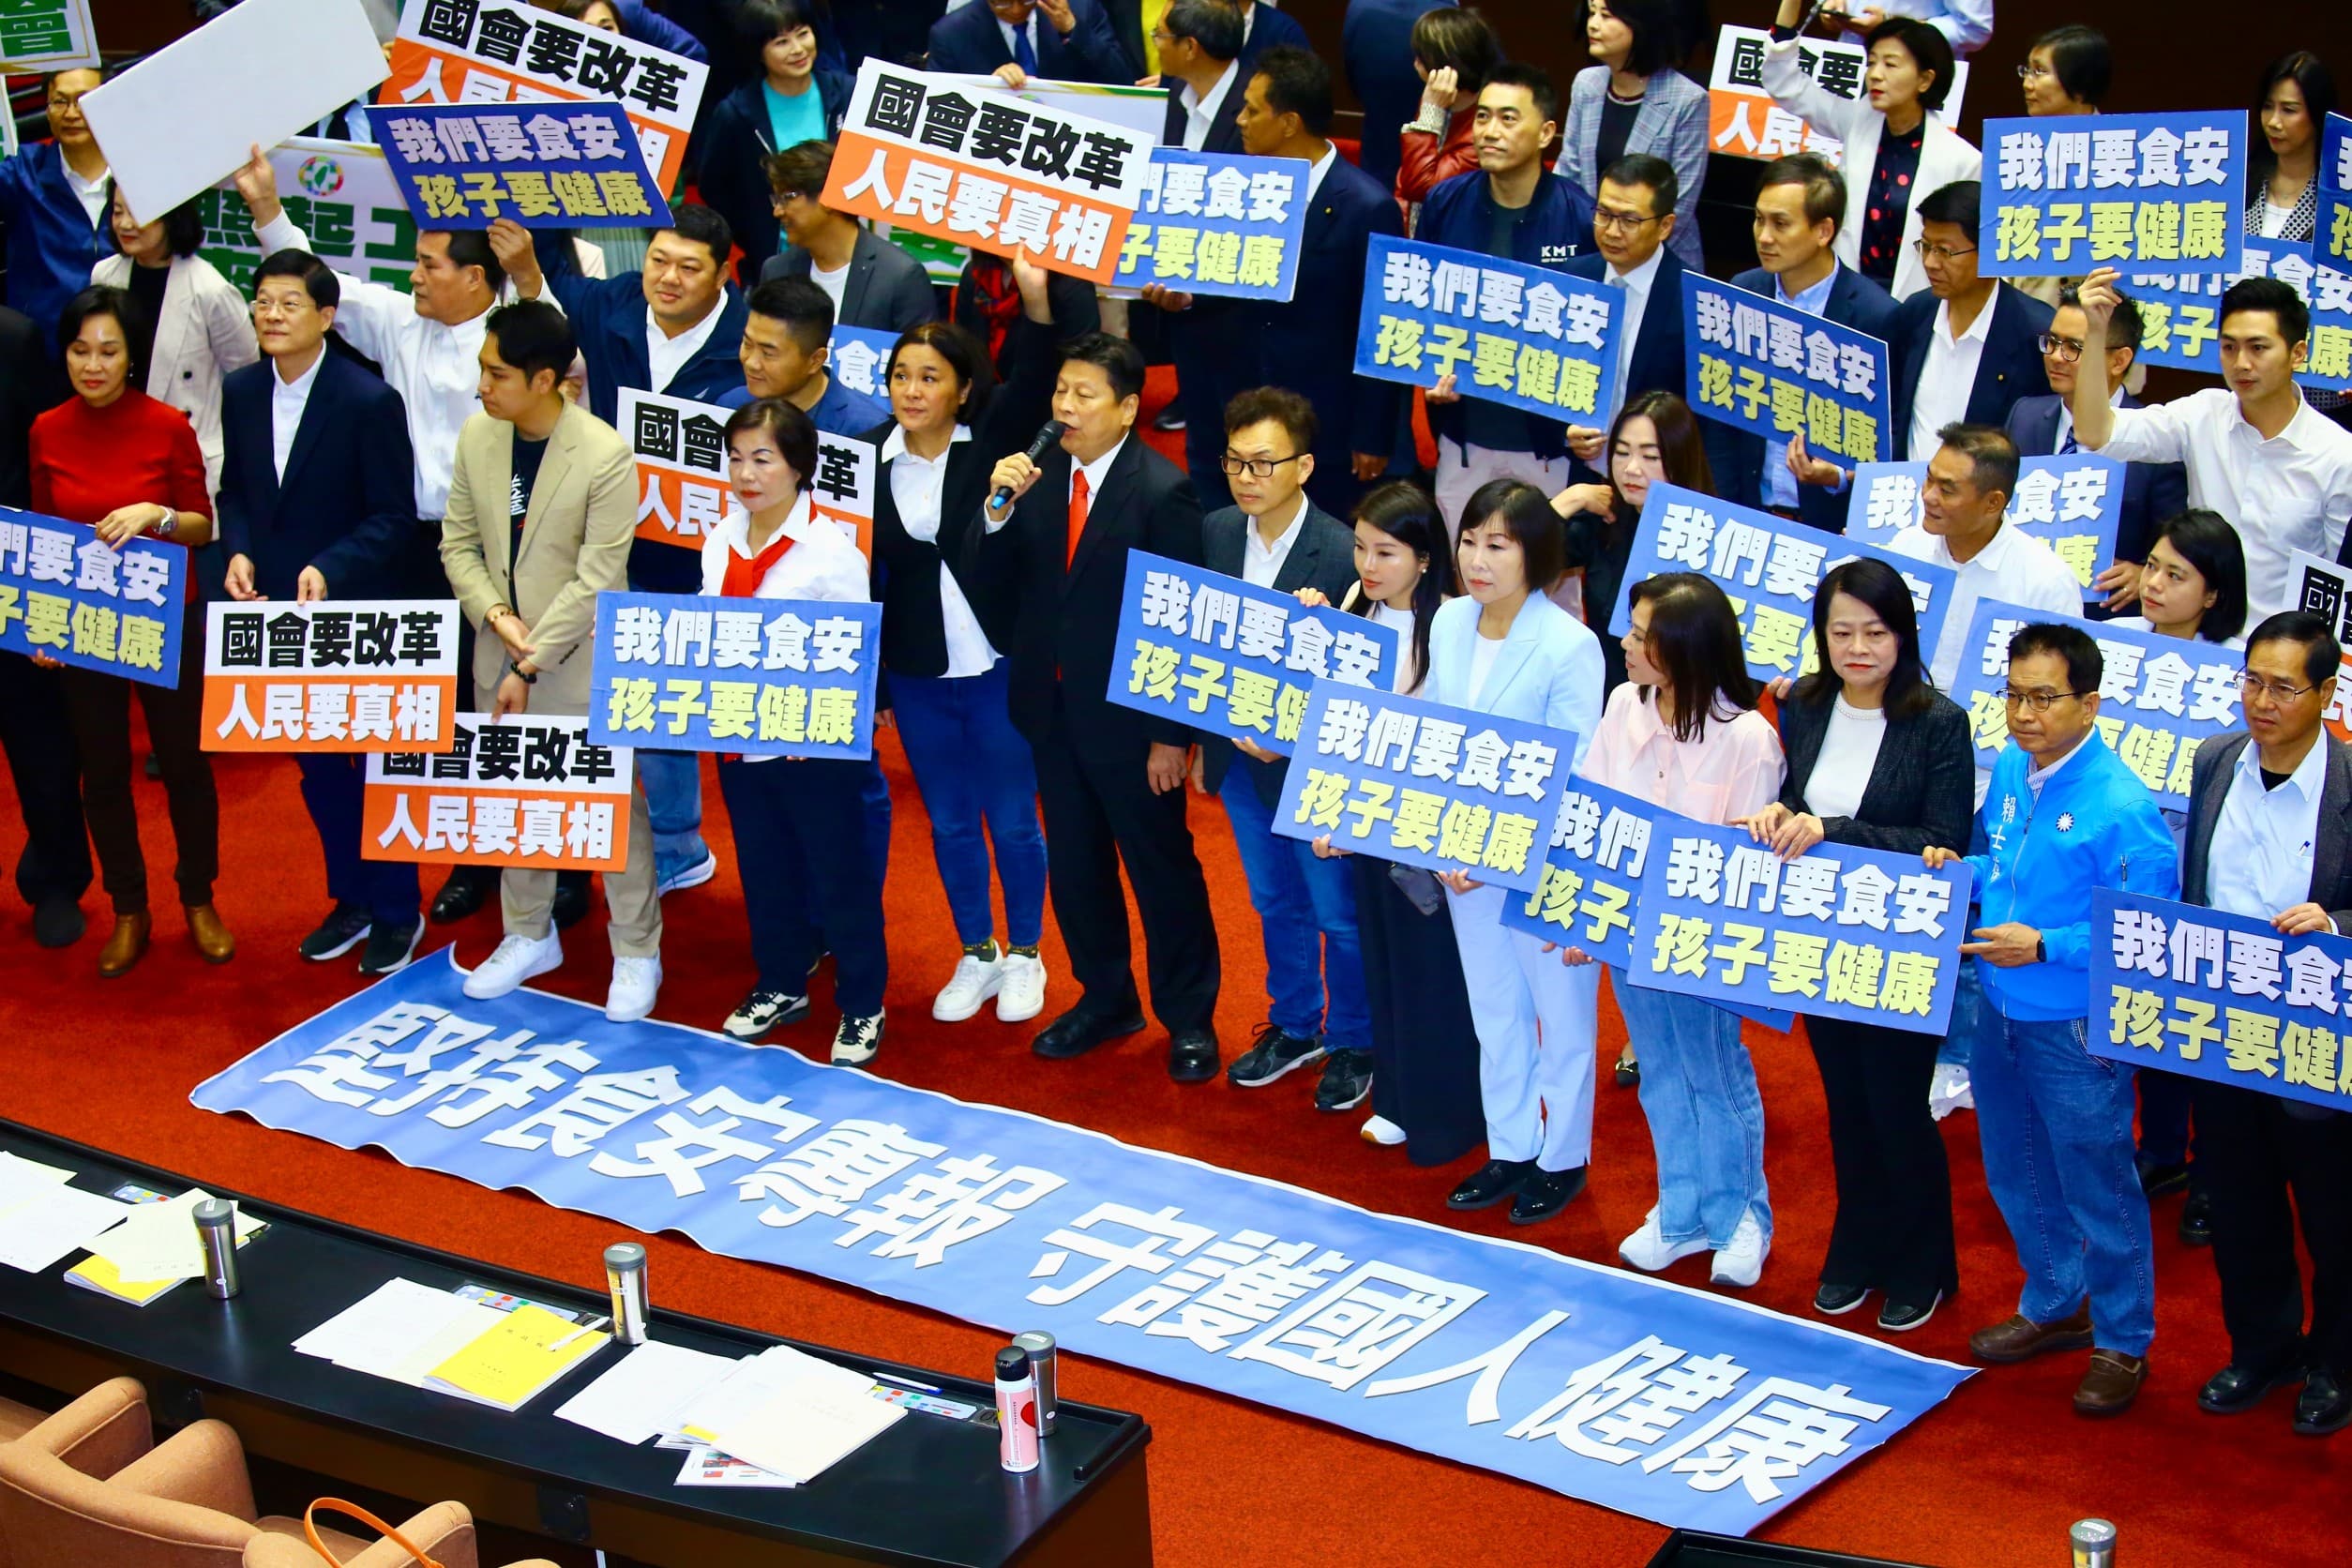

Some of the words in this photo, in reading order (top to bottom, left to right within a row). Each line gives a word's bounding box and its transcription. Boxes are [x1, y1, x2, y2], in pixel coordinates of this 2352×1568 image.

[419, 0, 687, 113] 國會要改革
[387, 113, 626, 164] 我們要食安
[865, 74, 1133, 190] 國會要改革
[1998, 127, 2229, 189] 我們要食安
[413, 171, 652, 219] 孩子要健康
[843, 149, 1113, 270] 人民要真相
[1996, 201, 2226, 262] 孩子要健康
[1383, 251, 1609, 350] 我們要食安
[1541, 244, 1577, 257] KMT
[1375, 314, 1601, 415] 孩子要健康
[1696, 291, 1876, 402] 我們要食安
[635, 401, 860, 501] 國會革
[1698, 353, 1877, 463] 孩子要健康
[1867, 467, 2109, 529] 我食安
[221, 611, 443, 667] 國會要改革
[613, 606, 863, 674] 我們要食安
[1142, 570, 1381, 689] 我們要食安
[217, 684, 441, 742] 人民要真相
[608, 677, 857, 746] 孩子要健康
[1318, 697, 1559, 803] 我們要食安
[378, 793, 614, 860] 人民要真相
[1294, 768, 1538, 876] 孩子要健康
[1524, 862, 1640, 955] 孩子
[1666, 837, 1952, 939] 我們要食安
[1651, 912, 1941, 1018] 孩子要健康
[2112, 909, 2352, 1018] 我們要食
[2108, 985, 2352, 1097] 孩子要健
[261, 1001, 1068, 1269] 堅持食安專報
[1027, 1202, 1892, 1505] 守護國人健康
